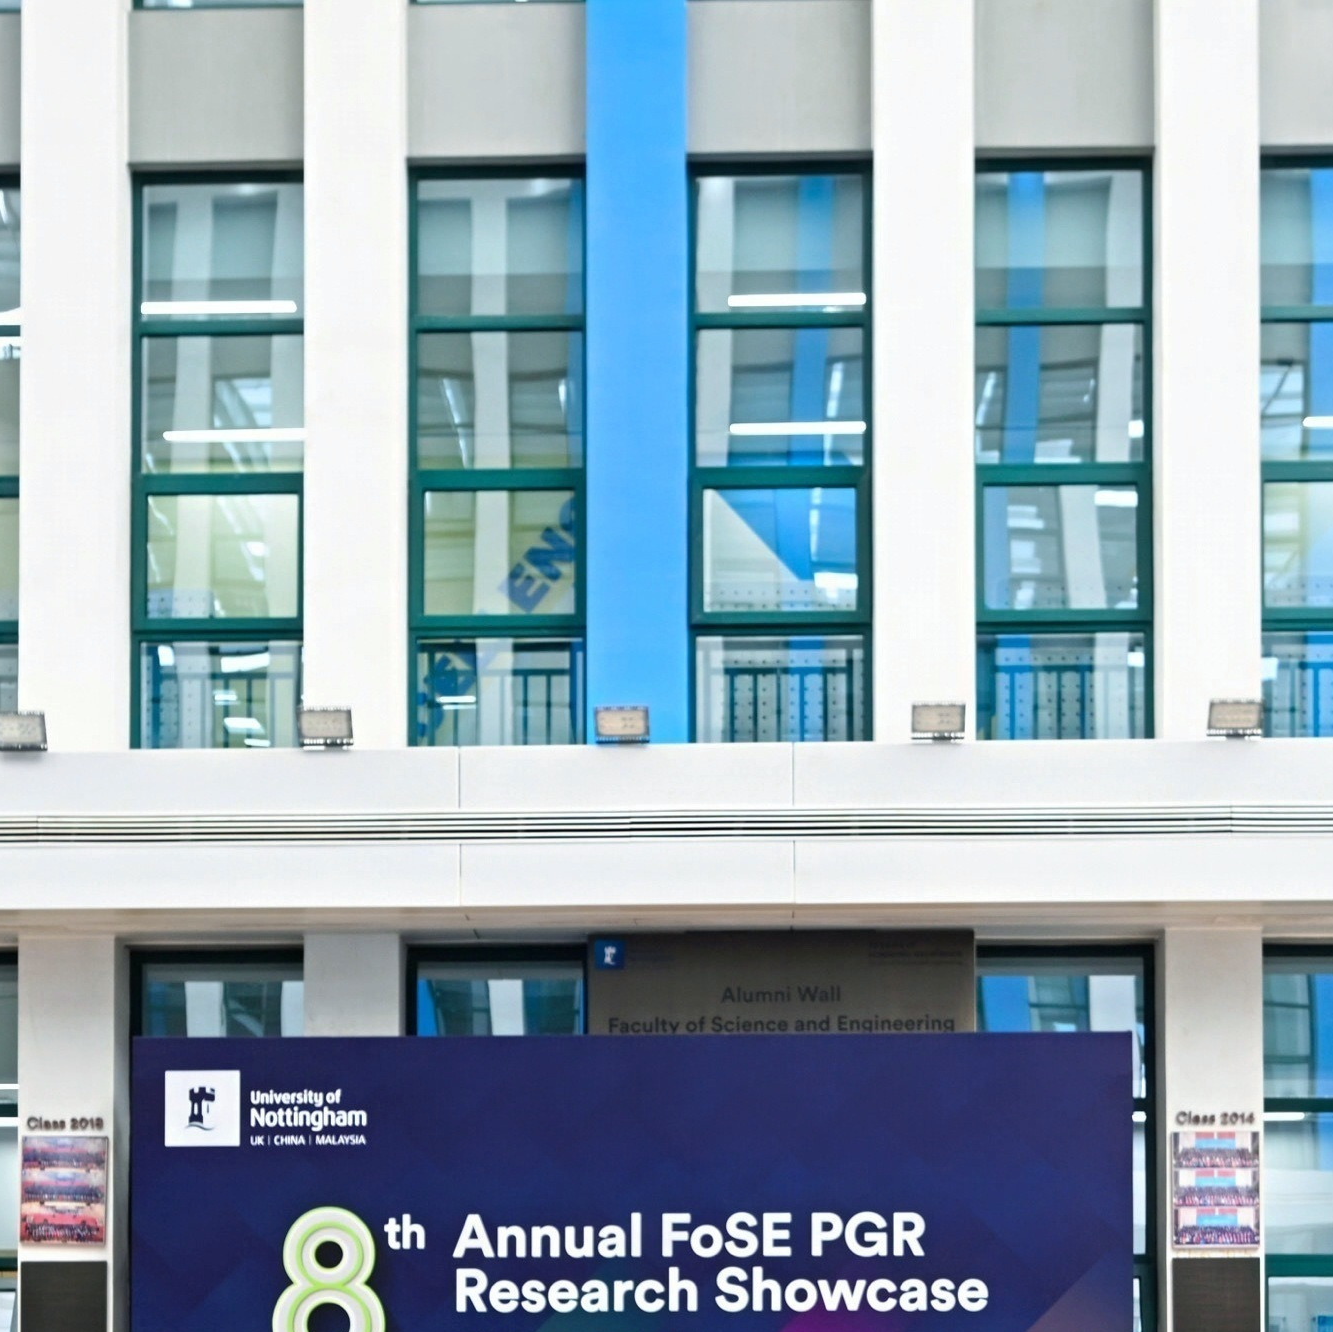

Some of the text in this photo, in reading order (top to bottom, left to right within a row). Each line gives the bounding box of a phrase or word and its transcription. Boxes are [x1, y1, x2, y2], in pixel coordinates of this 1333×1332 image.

[721, 986, 840, 1002] Alumni Wall
[609, 1015, 954, 1034] Faculty of Science and Engineering
[251, 1089, 341, 1107] University of
[28, 1117, 104, 1130] Class 2018
[251, 1107, 367, 1131] Nottingham
[1176, 1112, 1255, 1125] Class 2014
[251, 1135, 366, 1145] UK CHINA MALAYSIA
[385, 1214, 426, 1250] th
[453, 1213, 641, 1258] Annual
[661, 1213, 791, 1258] FoSE
[811, 1211, 925, 1257] PGR
[455, 1267, 988, 1314] Research Showcase
